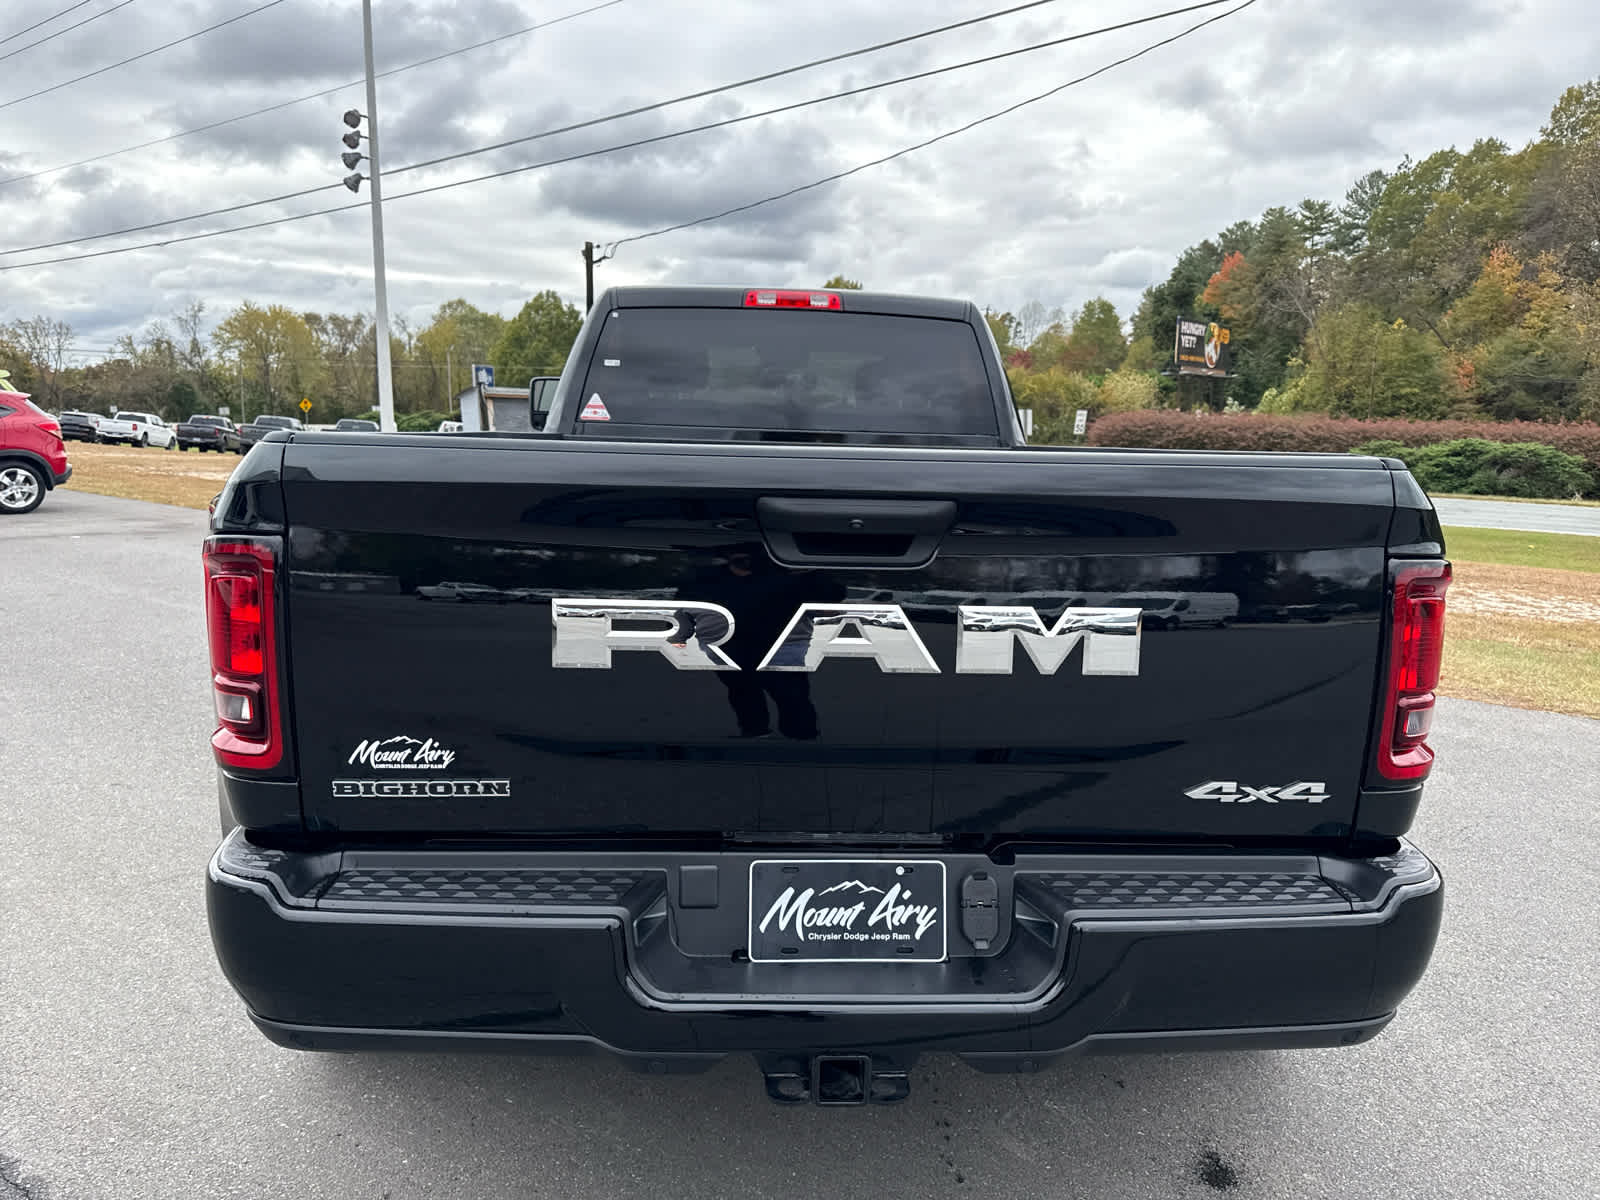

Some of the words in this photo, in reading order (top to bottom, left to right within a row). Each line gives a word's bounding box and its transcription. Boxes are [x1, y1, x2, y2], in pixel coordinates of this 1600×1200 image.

[1181, 334, 1198, 349] YET?
[551, 598, 1143, 676] RAM
[348, 739, 412, 769] Mount
[413, 737, 456, 769] Airy
[332, 780, 511, 798] BIGHORN
[1183, 780, 1332, 804] 4x4
[758, 886, 866, 942] Mount
[867, 882, 938, 941] Airy
[807, 932, 842, 941] Chrysler
[843, 932, 870, 941] Dodge
[871, 932, 891, 941] Jeep
[892, 932, 911, 940] Ram
